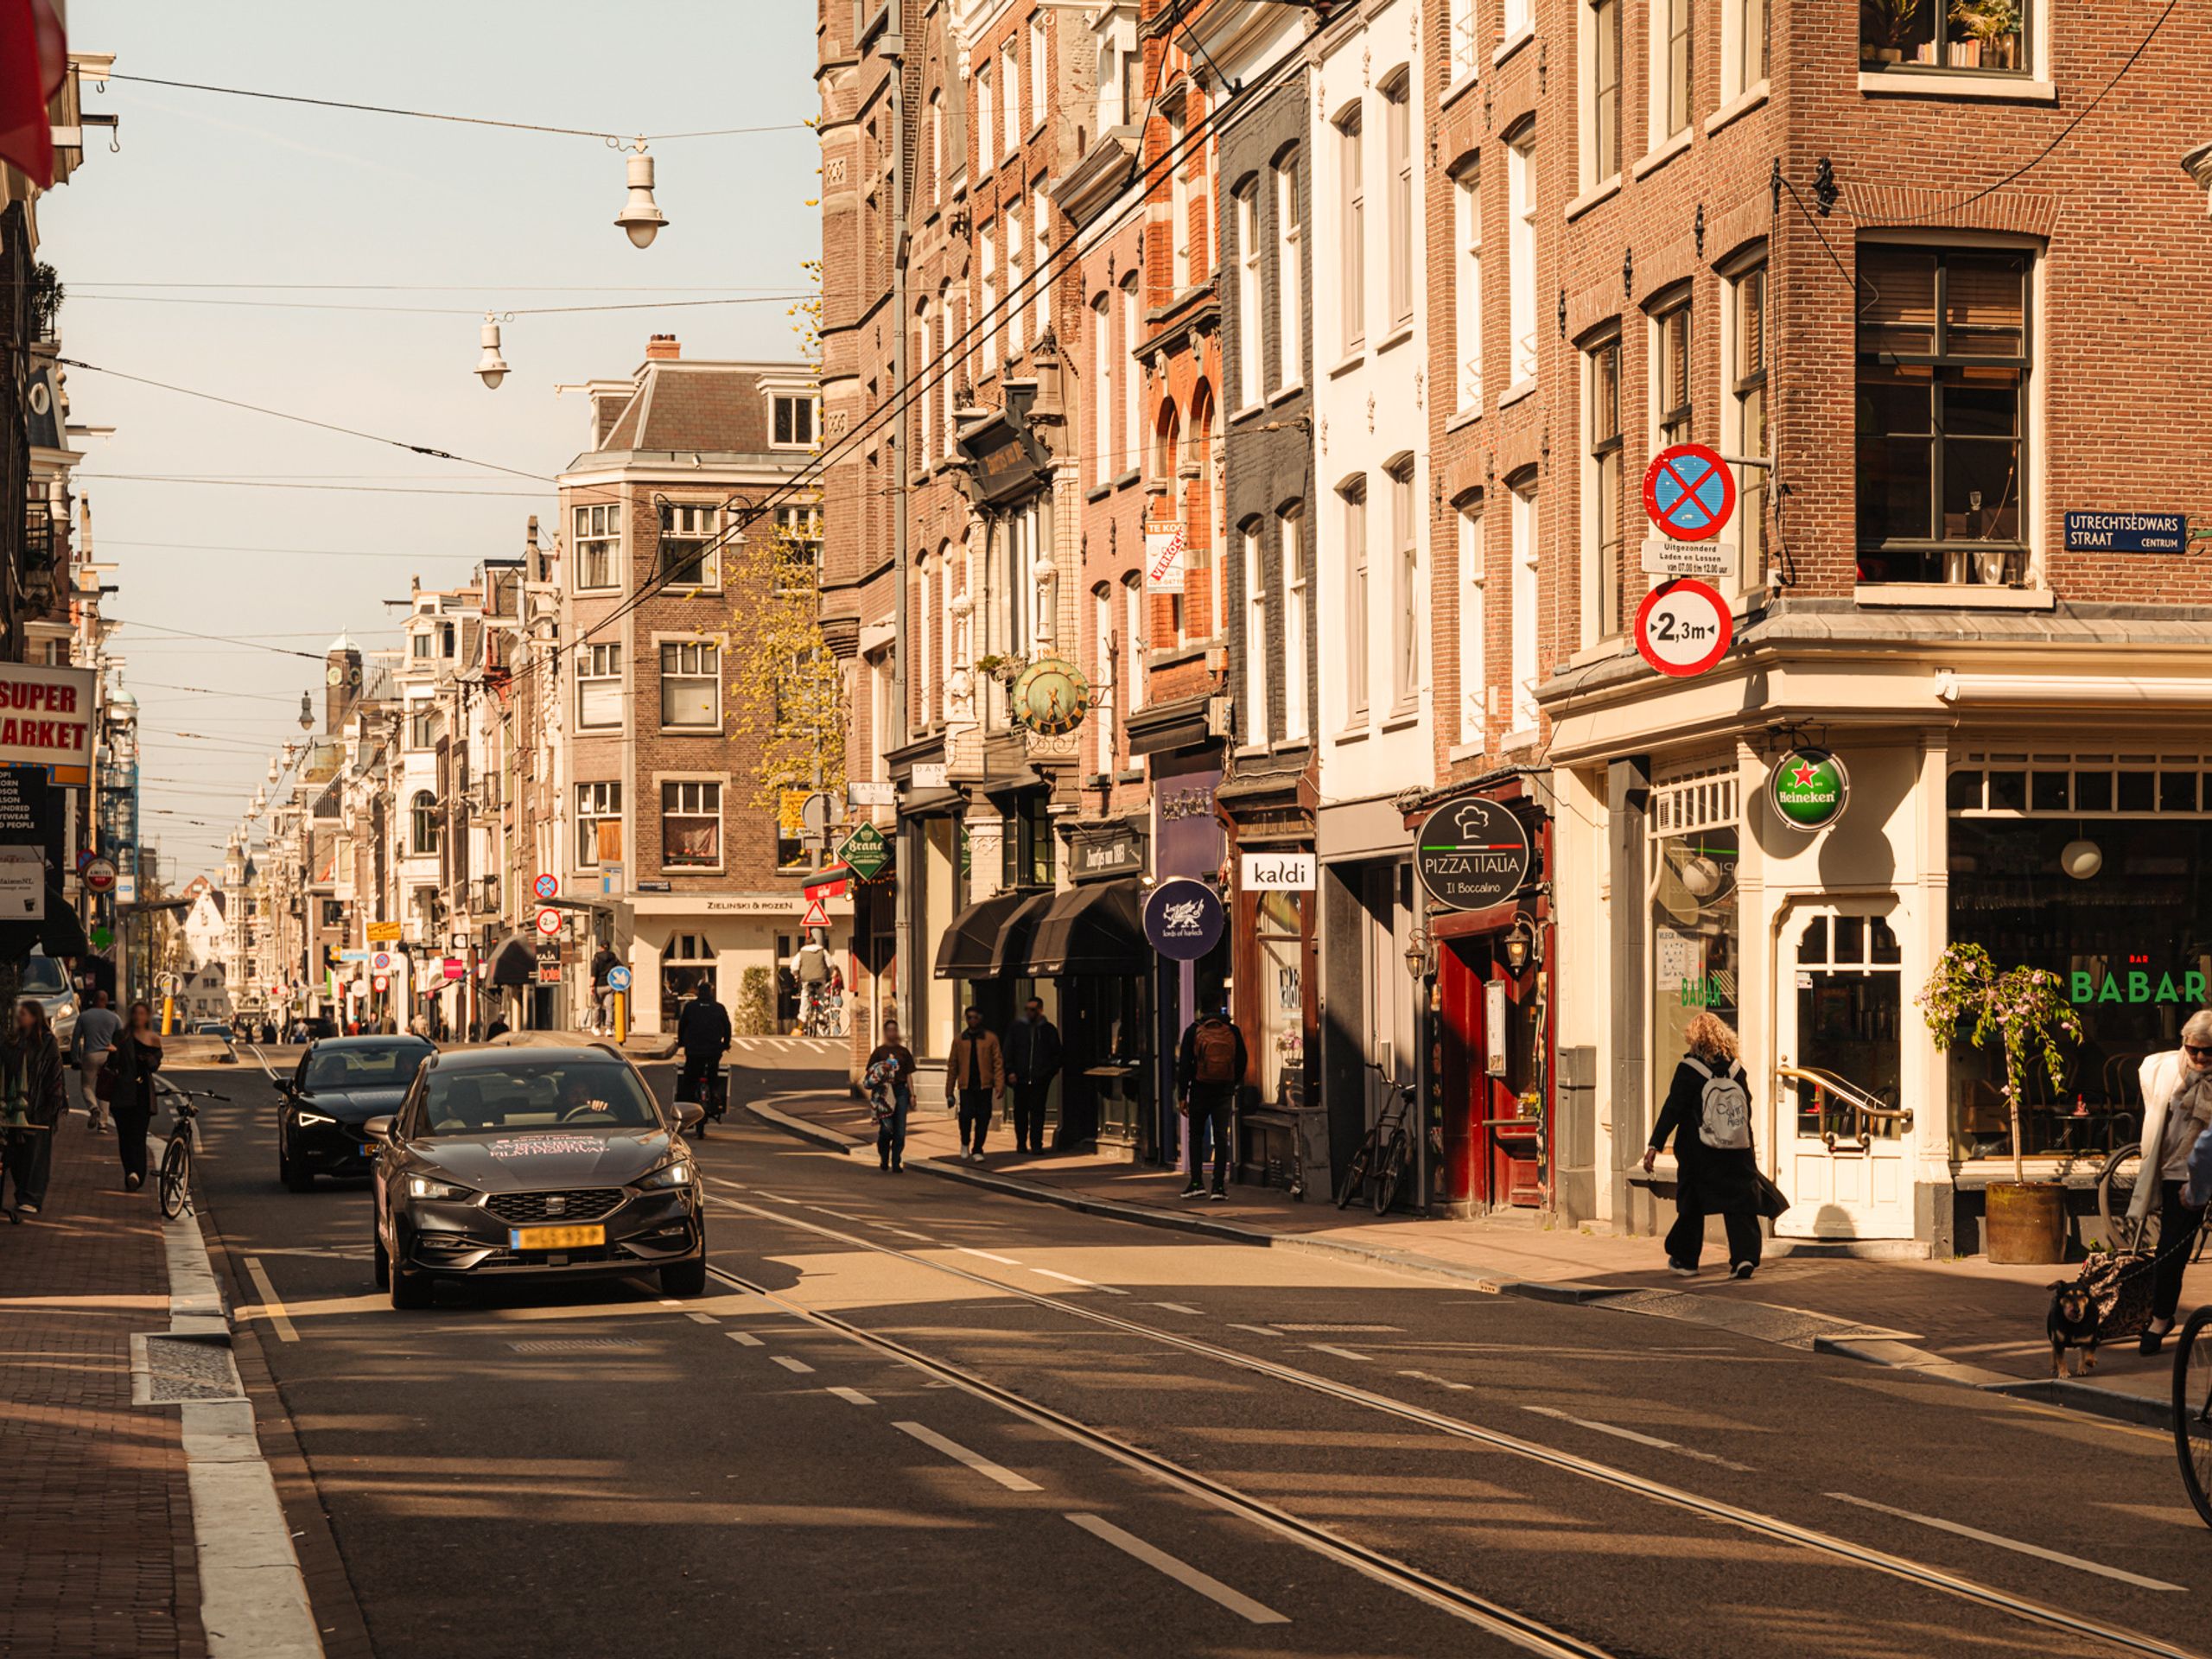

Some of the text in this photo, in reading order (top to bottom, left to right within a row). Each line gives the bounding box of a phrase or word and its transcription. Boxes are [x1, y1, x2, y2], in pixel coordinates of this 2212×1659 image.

[1664, 543, 1717, 553] Uitgezonderd
[2070, 532, 2177, 548] STRAAT CENTRUM
[1152, 526, 1185, 577] VERKOCH
[1657, 613, 1705, 642] 2,3m
[0, 680, 77, 714] SUPER
[0, 715, 89, 752] ARKET
[1779, 791, 1835, 803] Heineken
[1255, 861, 1305, 883] kaldi
[1425, 854, 1520, 874] PIZZA ITALIA
[1446, 882, 1502, 893] Il Boccalino
[707, 901, 750, 910] ZIELINSKI
[2129, 954, 2149, 963] BAR
[1681, 977, 1721, 1007] BABAR
[2071, 970, 2208, 1003] BABAR
